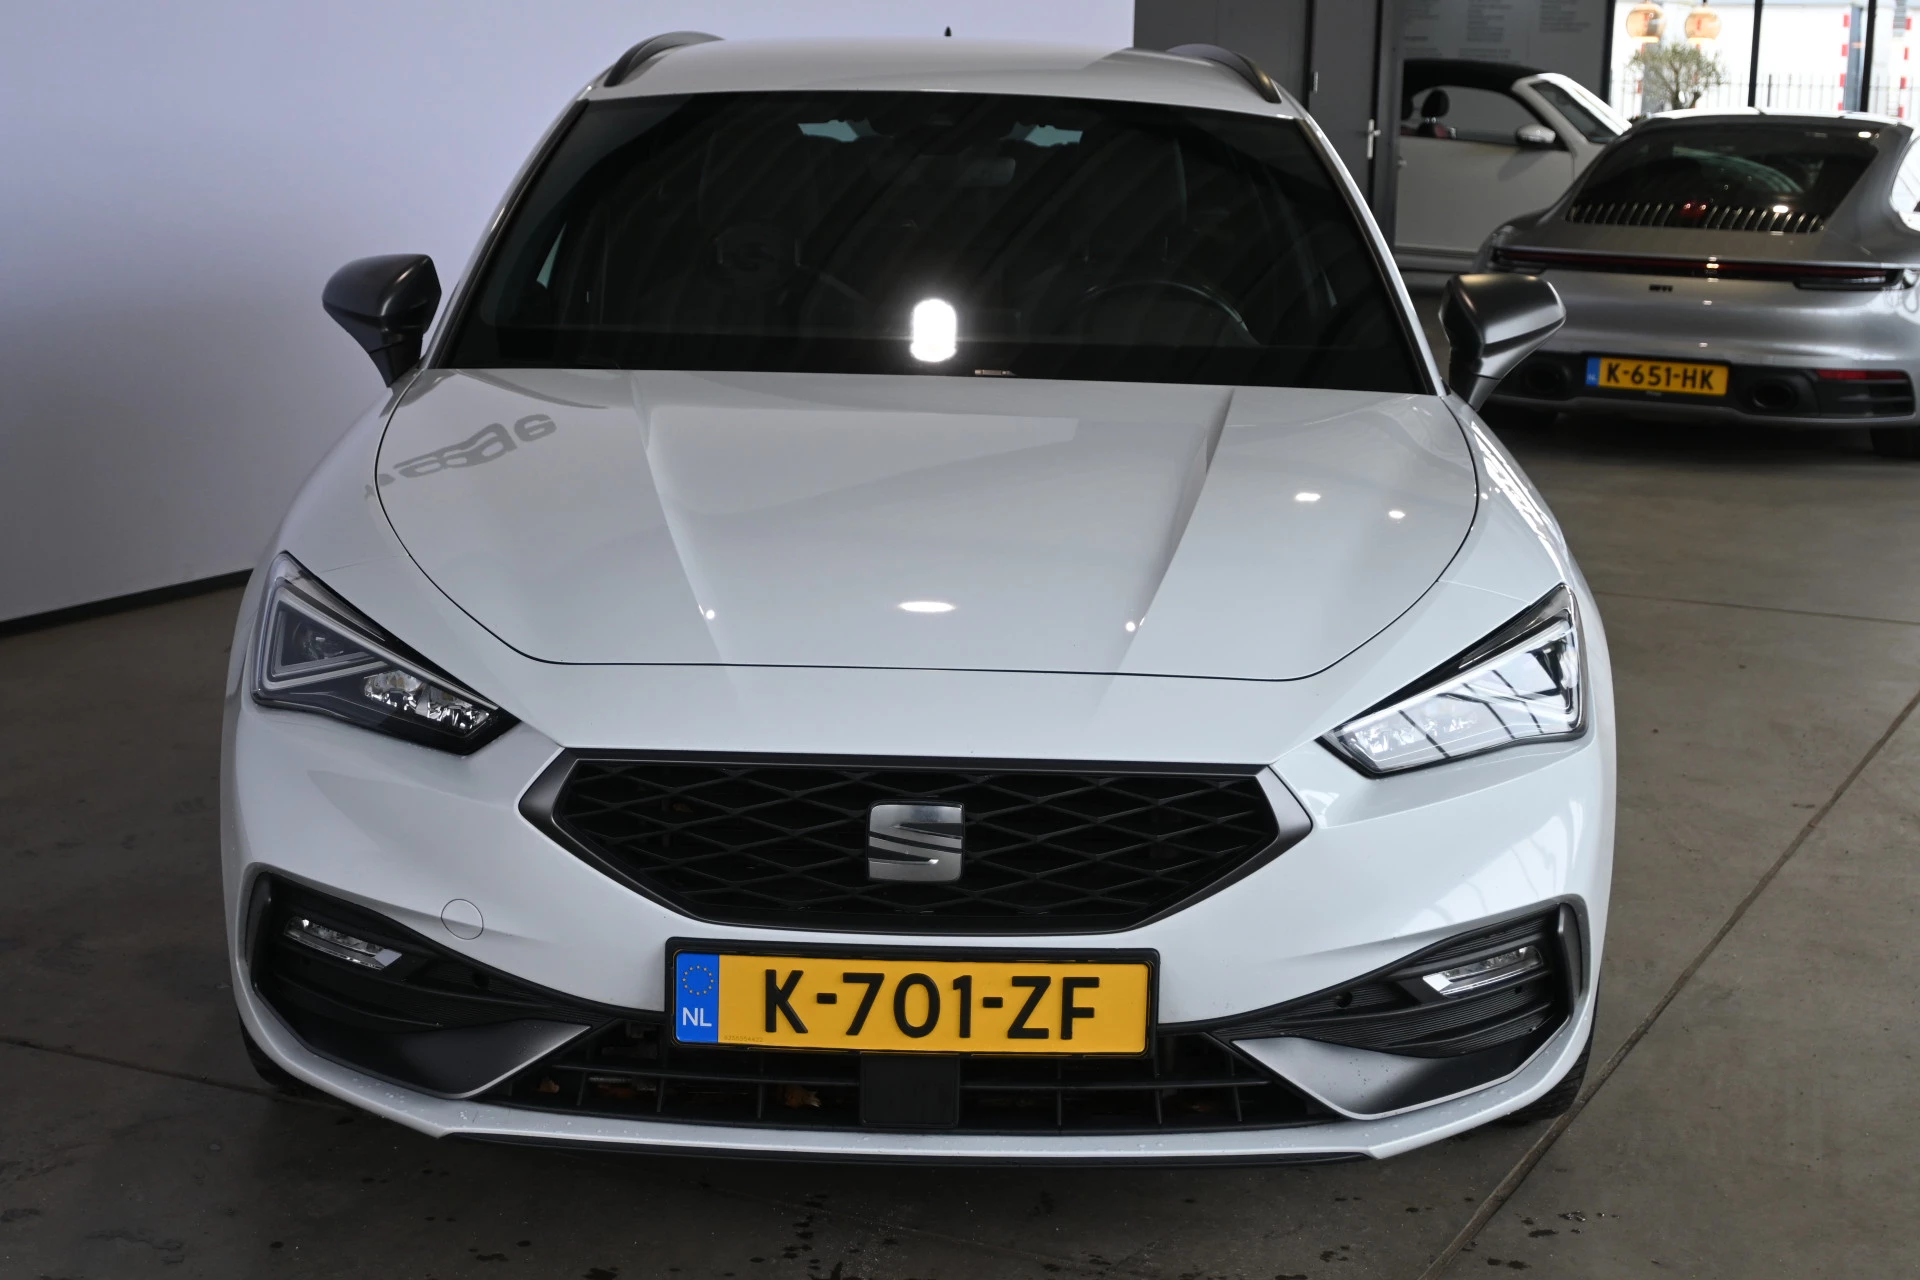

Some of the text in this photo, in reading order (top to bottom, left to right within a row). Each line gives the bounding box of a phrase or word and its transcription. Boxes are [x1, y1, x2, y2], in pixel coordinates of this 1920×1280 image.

[1608, 363, 1714, 391] K-651-HK
[682, 968, 1101, 1041] NL K-701-ZF
